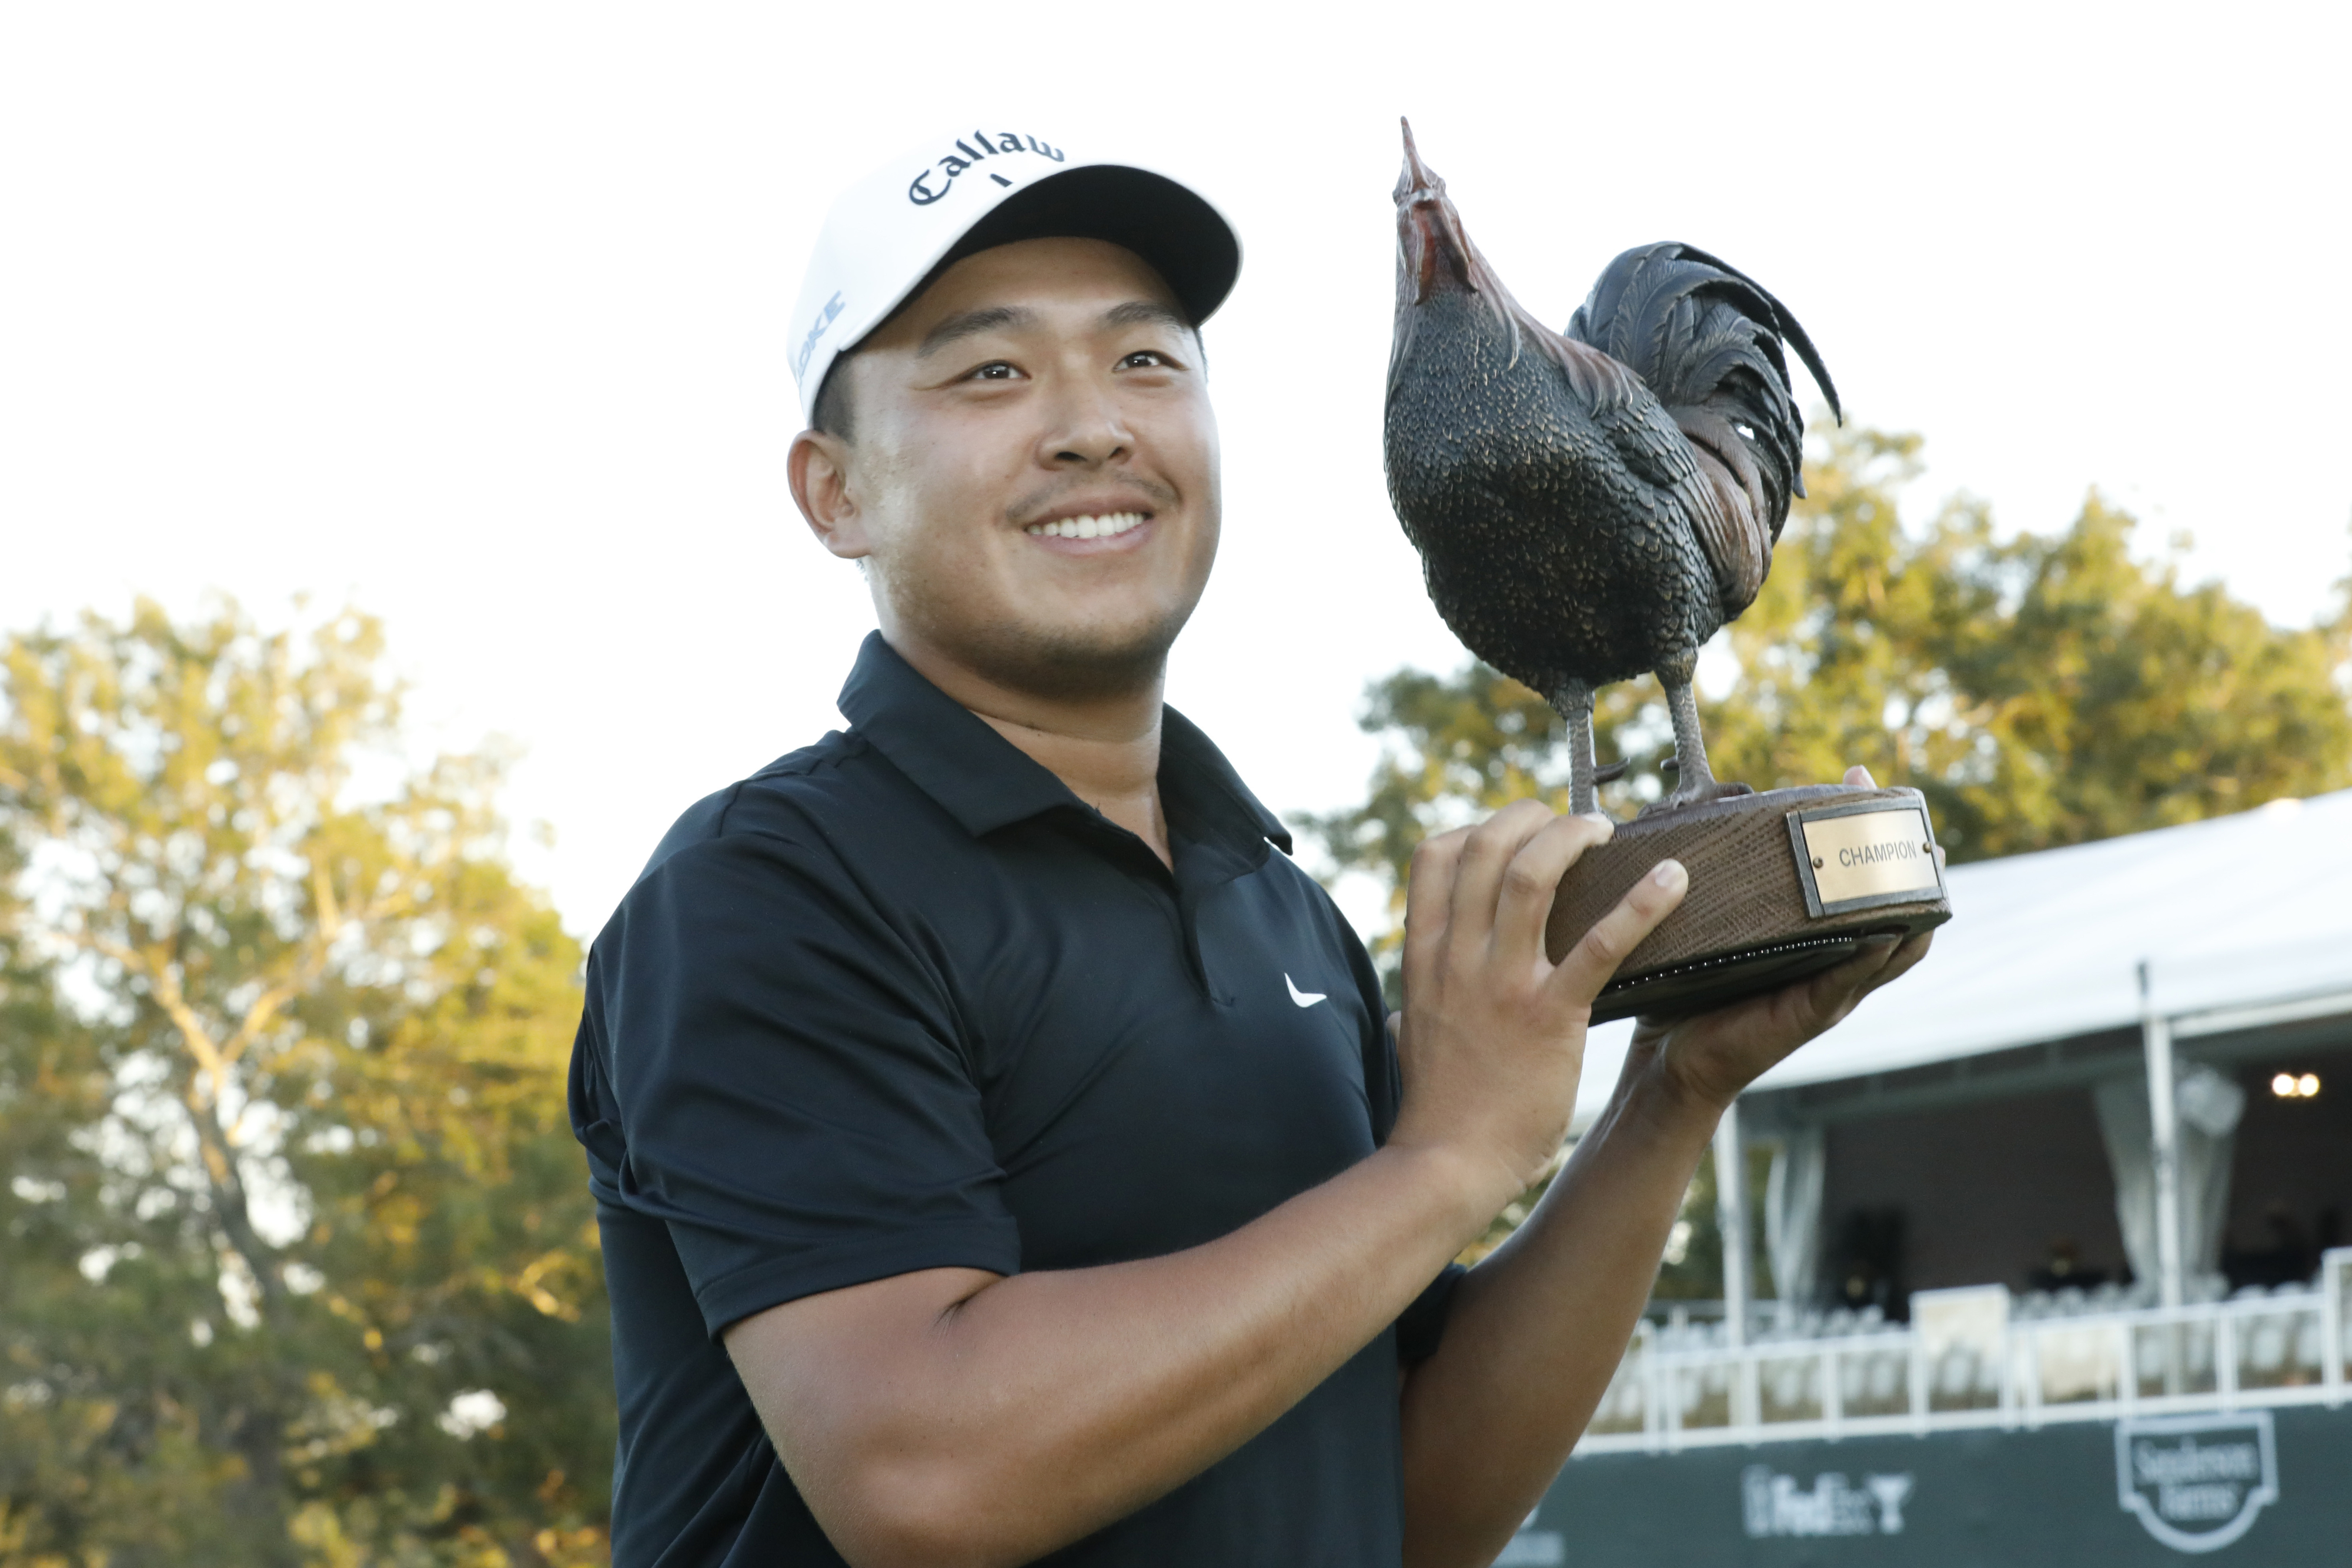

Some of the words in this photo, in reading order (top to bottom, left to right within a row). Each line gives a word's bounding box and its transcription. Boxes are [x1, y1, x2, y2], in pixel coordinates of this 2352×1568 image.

[909, 129, 1064, 206] Callaw
[796, 290, 846, 378] OKE
[1839, 840, 1917, 867] CHAMPION
